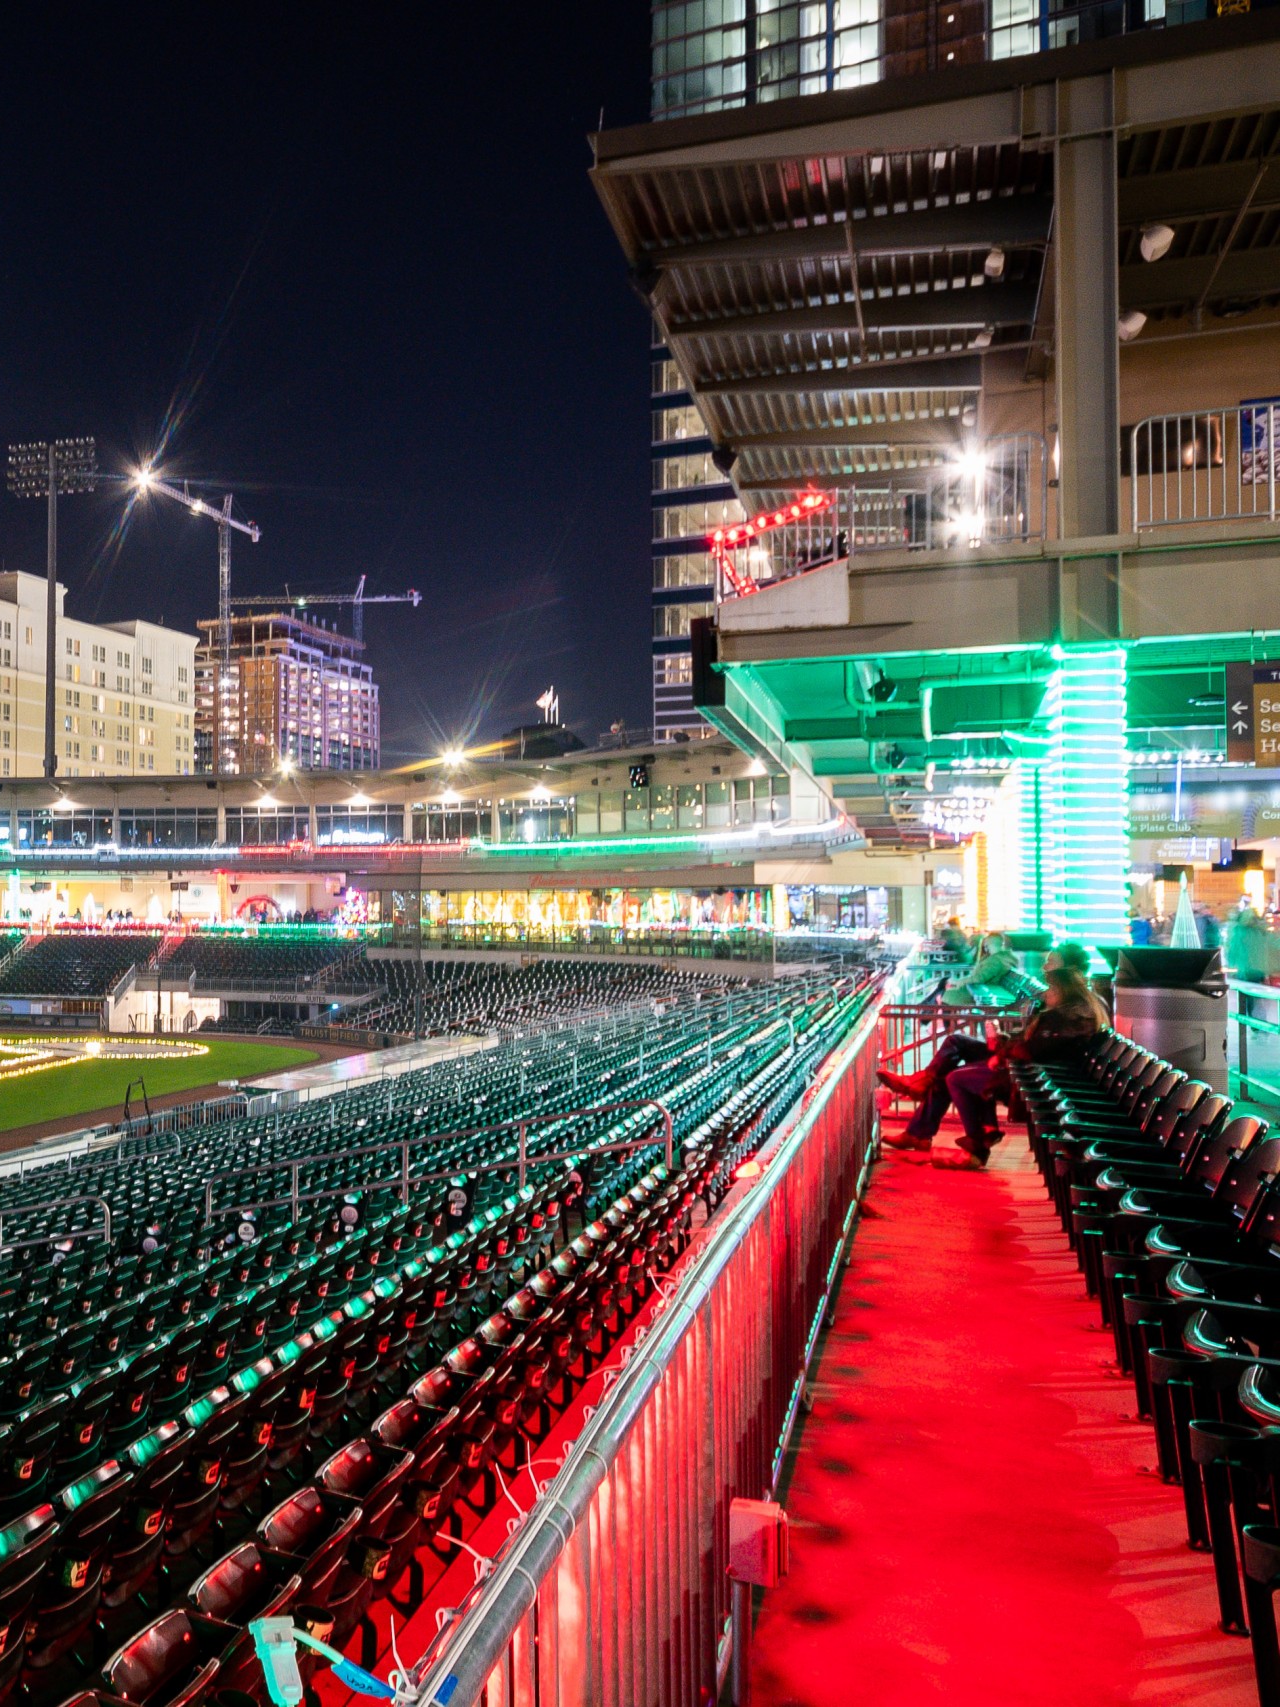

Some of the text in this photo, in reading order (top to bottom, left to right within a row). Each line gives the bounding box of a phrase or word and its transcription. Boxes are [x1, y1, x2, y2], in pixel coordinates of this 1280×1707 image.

[1140, 823, 1165, 832] Plate
[1167, 822, 1192, 832] Club
[301, 1028, 360, 1041] TRUIST FIELD
